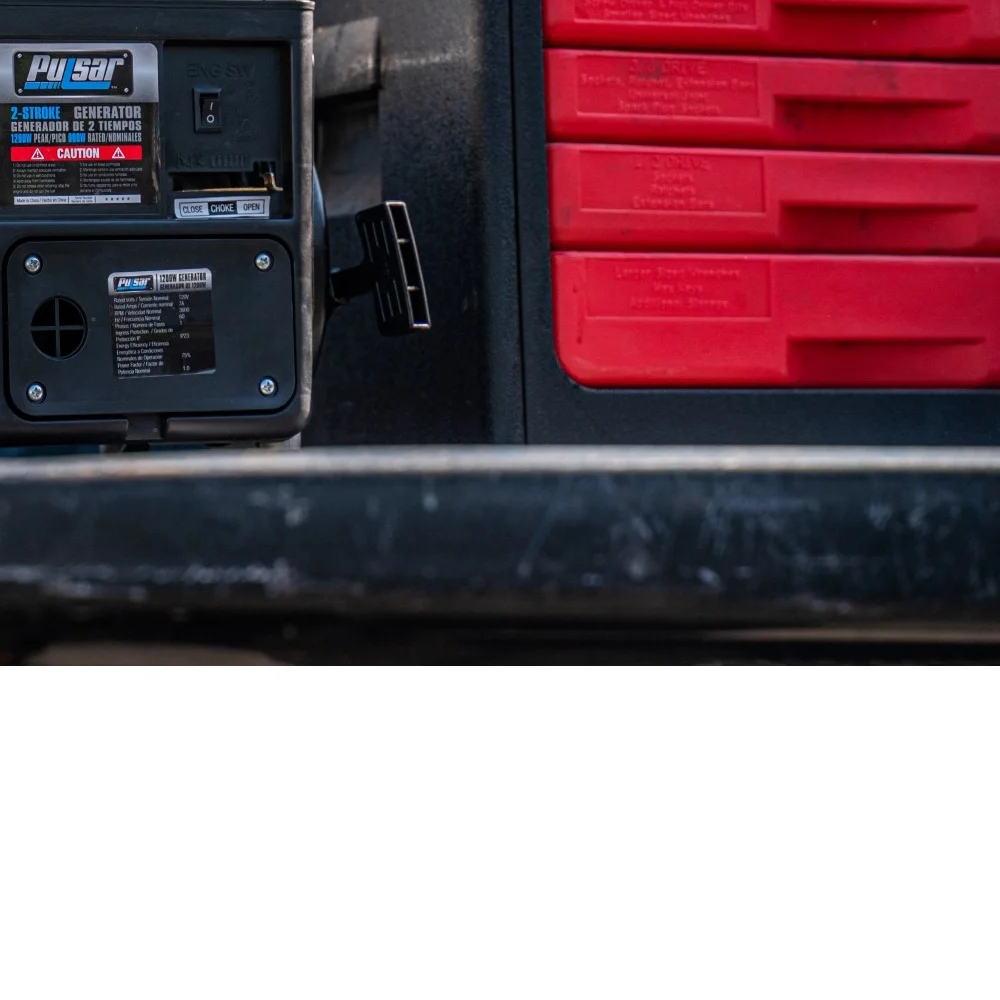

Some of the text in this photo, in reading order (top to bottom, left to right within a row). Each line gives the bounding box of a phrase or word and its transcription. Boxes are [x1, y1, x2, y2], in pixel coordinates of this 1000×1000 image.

[24, 54, 125, 90] Pulsar
[10, 105, 142, 120] 2-STROKE GENERATOR
[10, 120, 142, 132] GENERADOR DE 2 TIEMPOS
[33, 132, 66, 144] PEAK/PICO
[87, 132, 142, 143] RATED/NOMINALES
[57, 147, 100, 159] CAUTION
[182, 203, 260, 214] CLOSE CHOKE OPEN
[178, 272, 207, 282] GENERATOR
[117, 277, 151, 290] Pulsar
